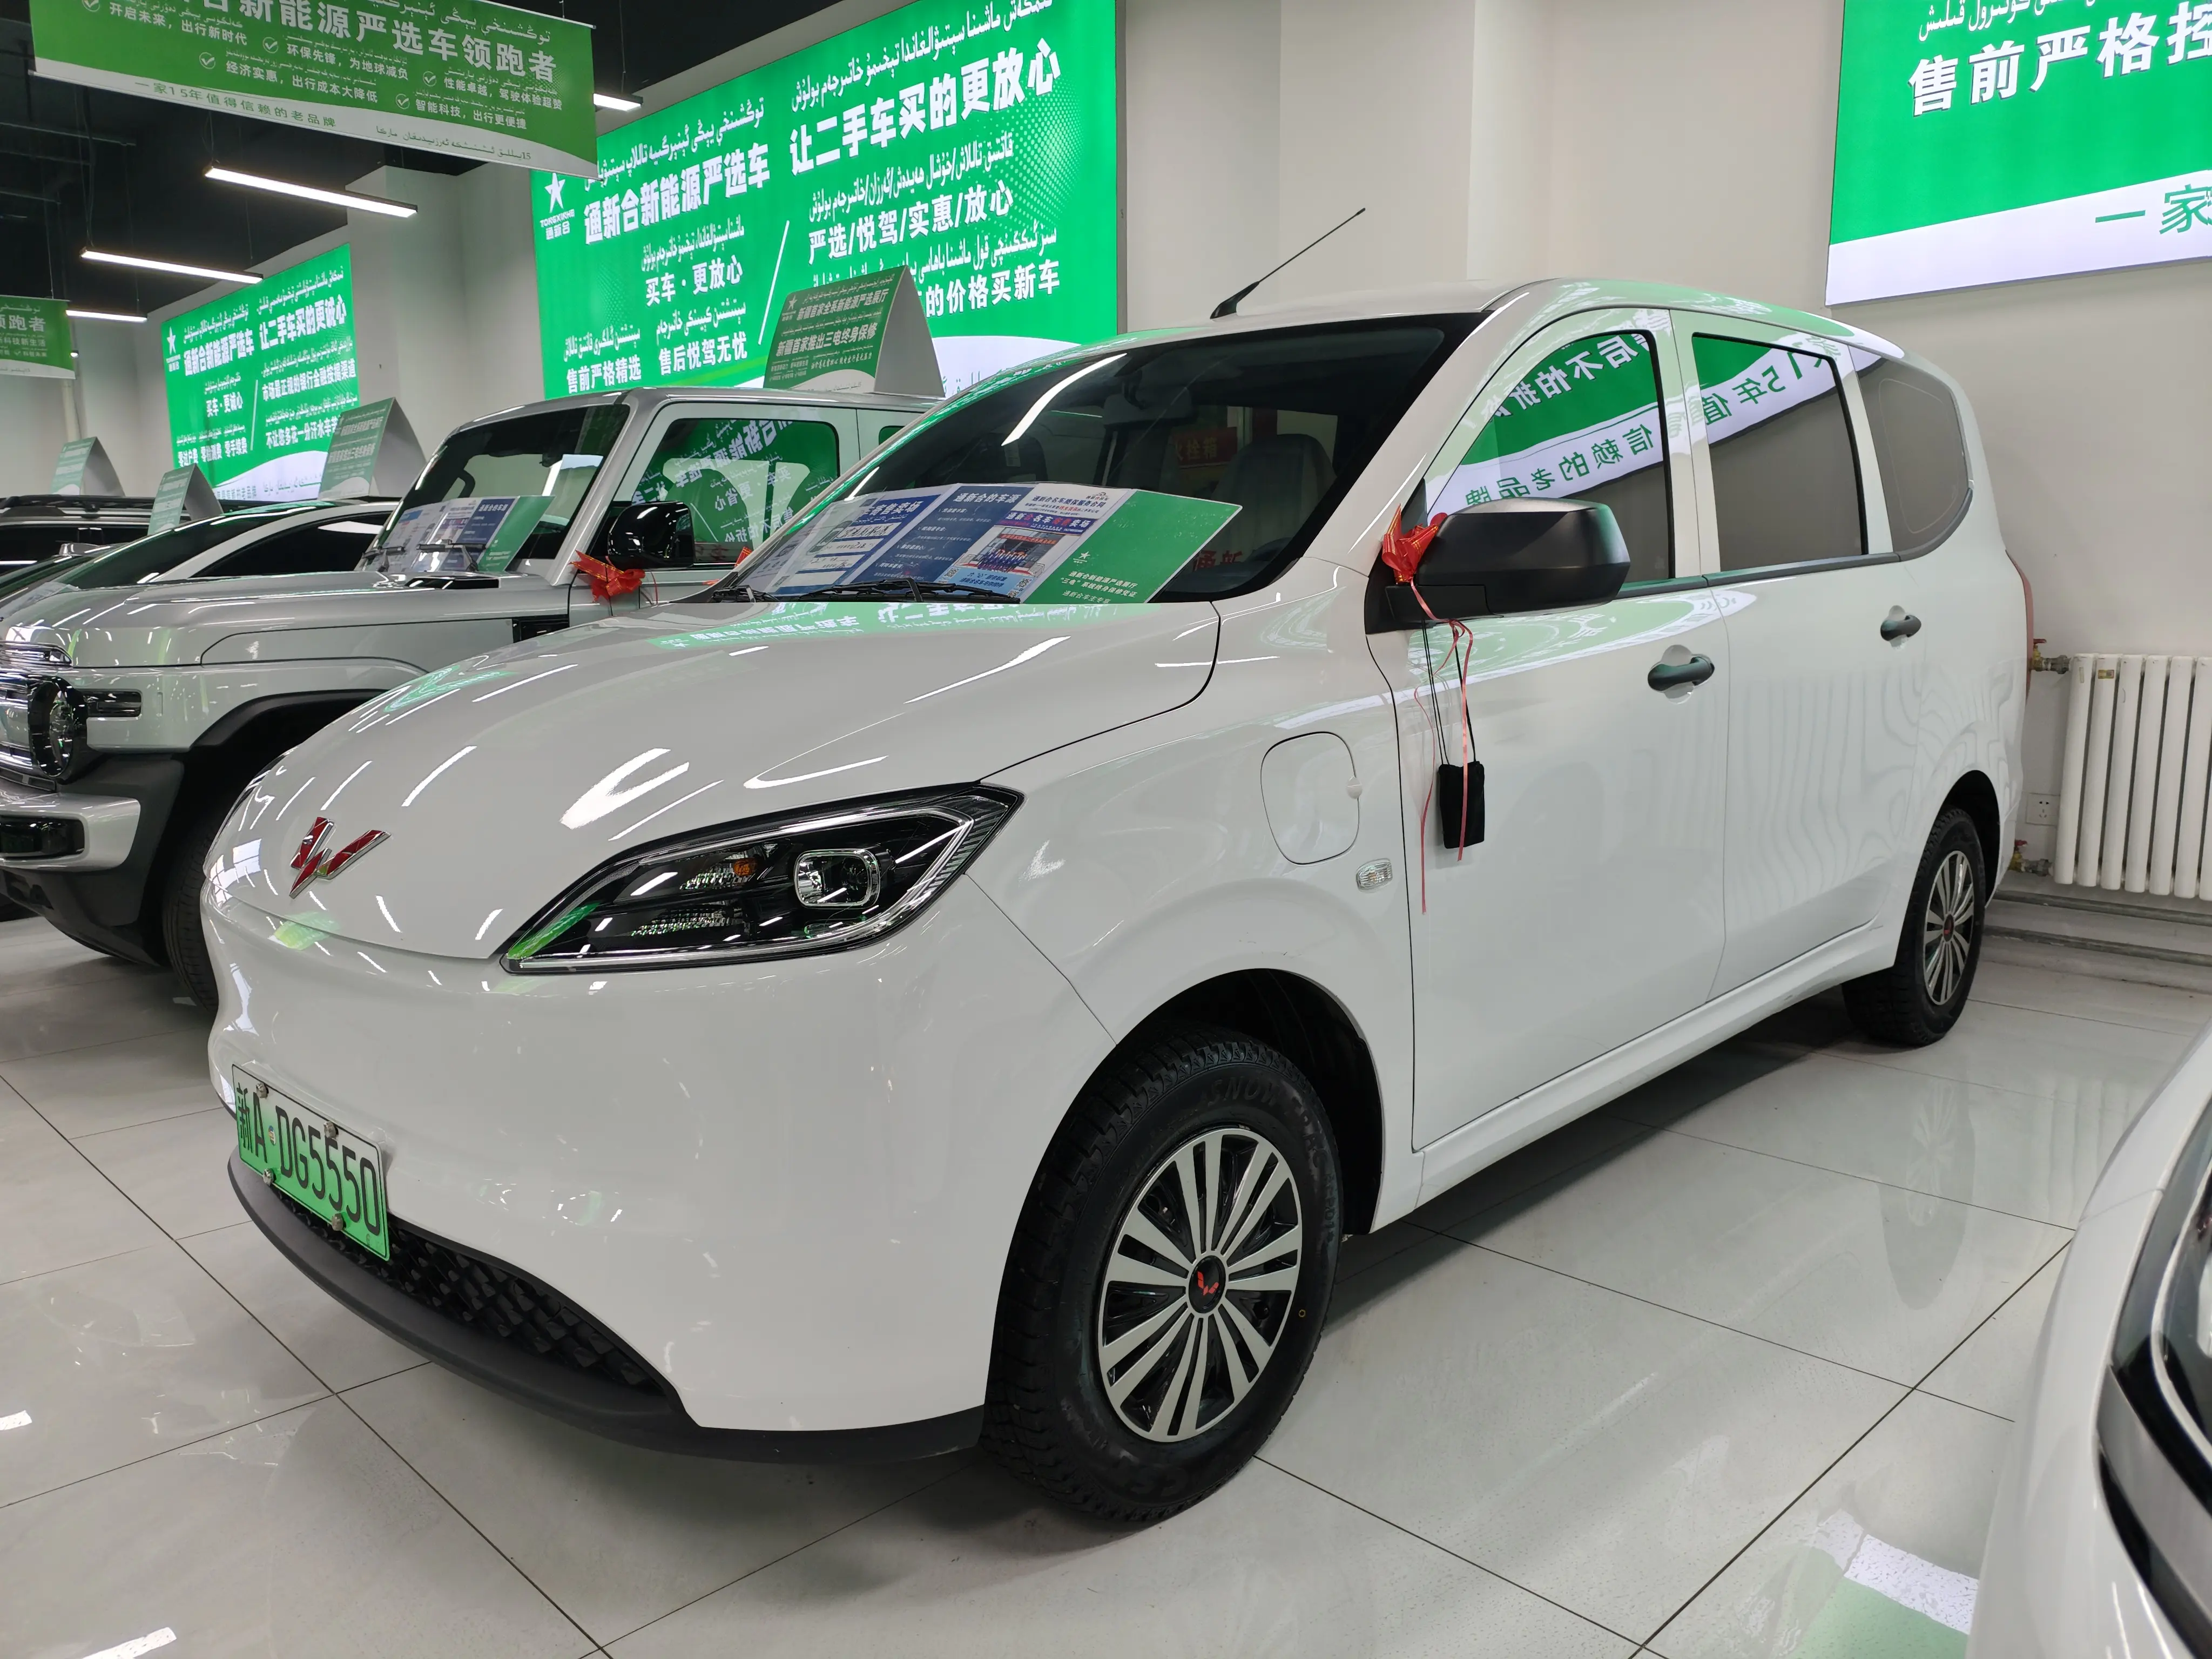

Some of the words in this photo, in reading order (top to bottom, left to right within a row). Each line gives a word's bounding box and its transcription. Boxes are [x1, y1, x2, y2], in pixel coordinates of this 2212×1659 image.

[110, 2, 247, 45] 开启未来，出行新时代
[226, 60, 378, 103] 经济实惠，出行成本大降低
[287, 43, 409, 80] 环保先锋，为地球减负
[135, 82, 336, 127] 一家15年值得信赖的老品牌
[415, 99, 527, 129] 智能科技，出行更便捷
[444, 77, 563, 110] 性能卓越，驾驶体验超赞
[789, 38, 1061, 177] 让二手车买的更放心
[584, 143, 771, 245] 通新合新能源严选车
[2095, 184, 2212, 235] 一家
[808, 180, 1014, 266] 严选/悦驾/实惠/放心
[918, 259, 1060, 319] 的价格买新车
[184, 328, 255, 376] 通新合新能源严选车
[567, 354, 642, 394] 售前严格精选
[658, 331, 748, 376] 售后悦驾无忧
[953, 493, 1022, 503] 通新合的车源
[1068, 571, 1138, 590] 通新合新能源严选展厅
